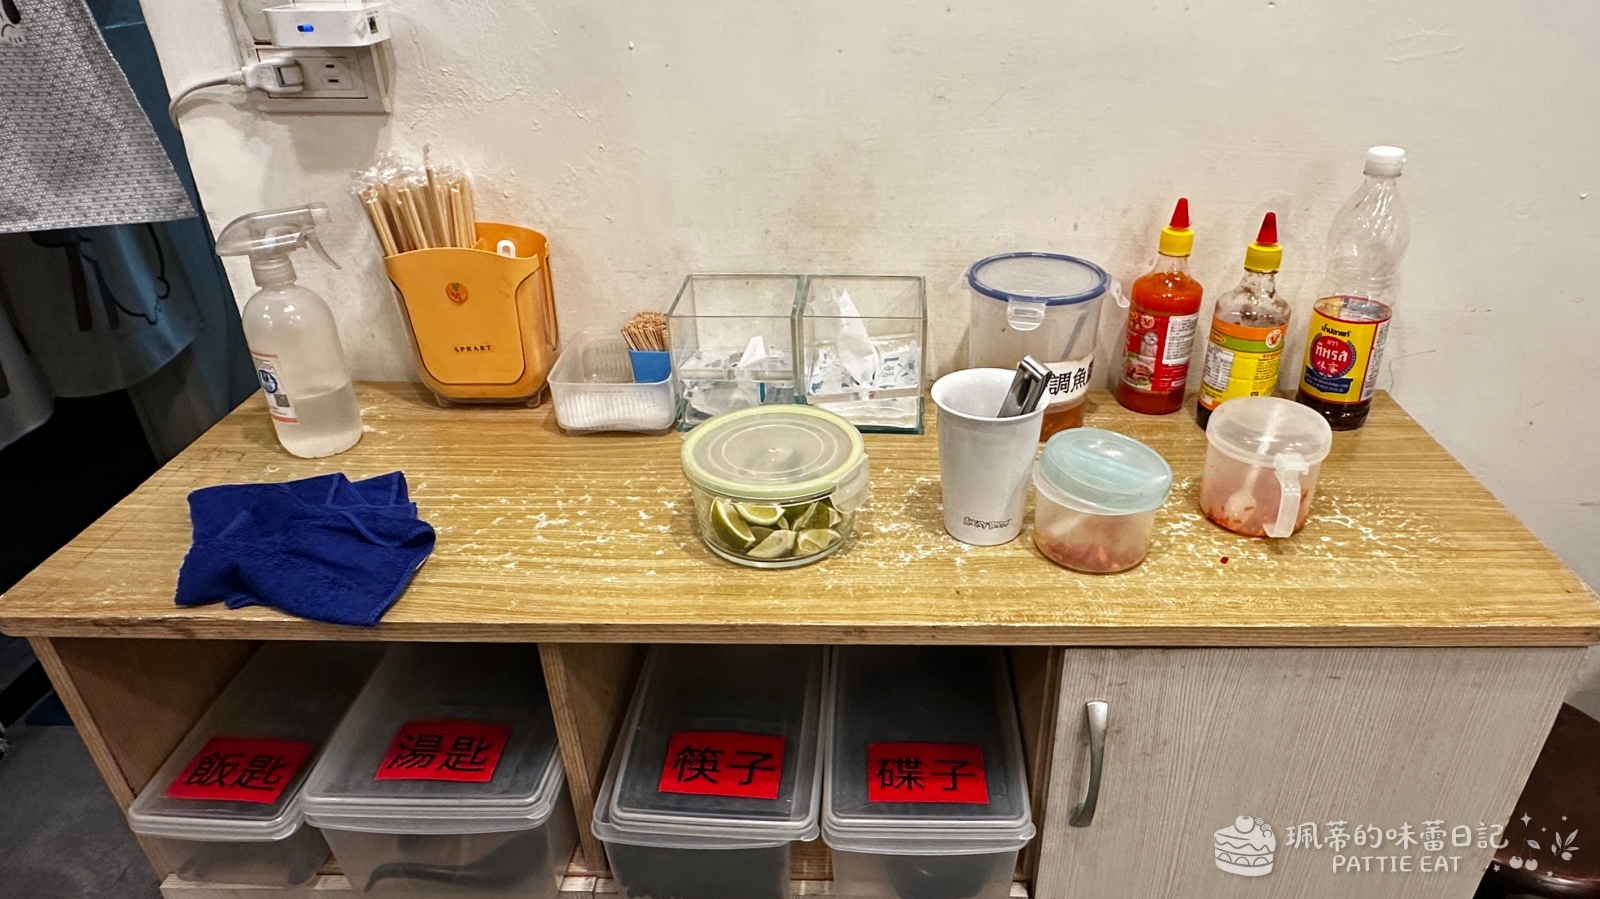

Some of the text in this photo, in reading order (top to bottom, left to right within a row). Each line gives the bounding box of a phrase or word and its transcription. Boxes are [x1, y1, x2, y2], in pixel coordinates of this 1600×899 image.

[454, 345, 491, 353] SPRART
[182, 751, 291, 791] 飯匙
[387, 733, 494, 773] 湯匙
[672, 743, 777, 785] 筷子
[876, 757, 977, 792] 碟子
